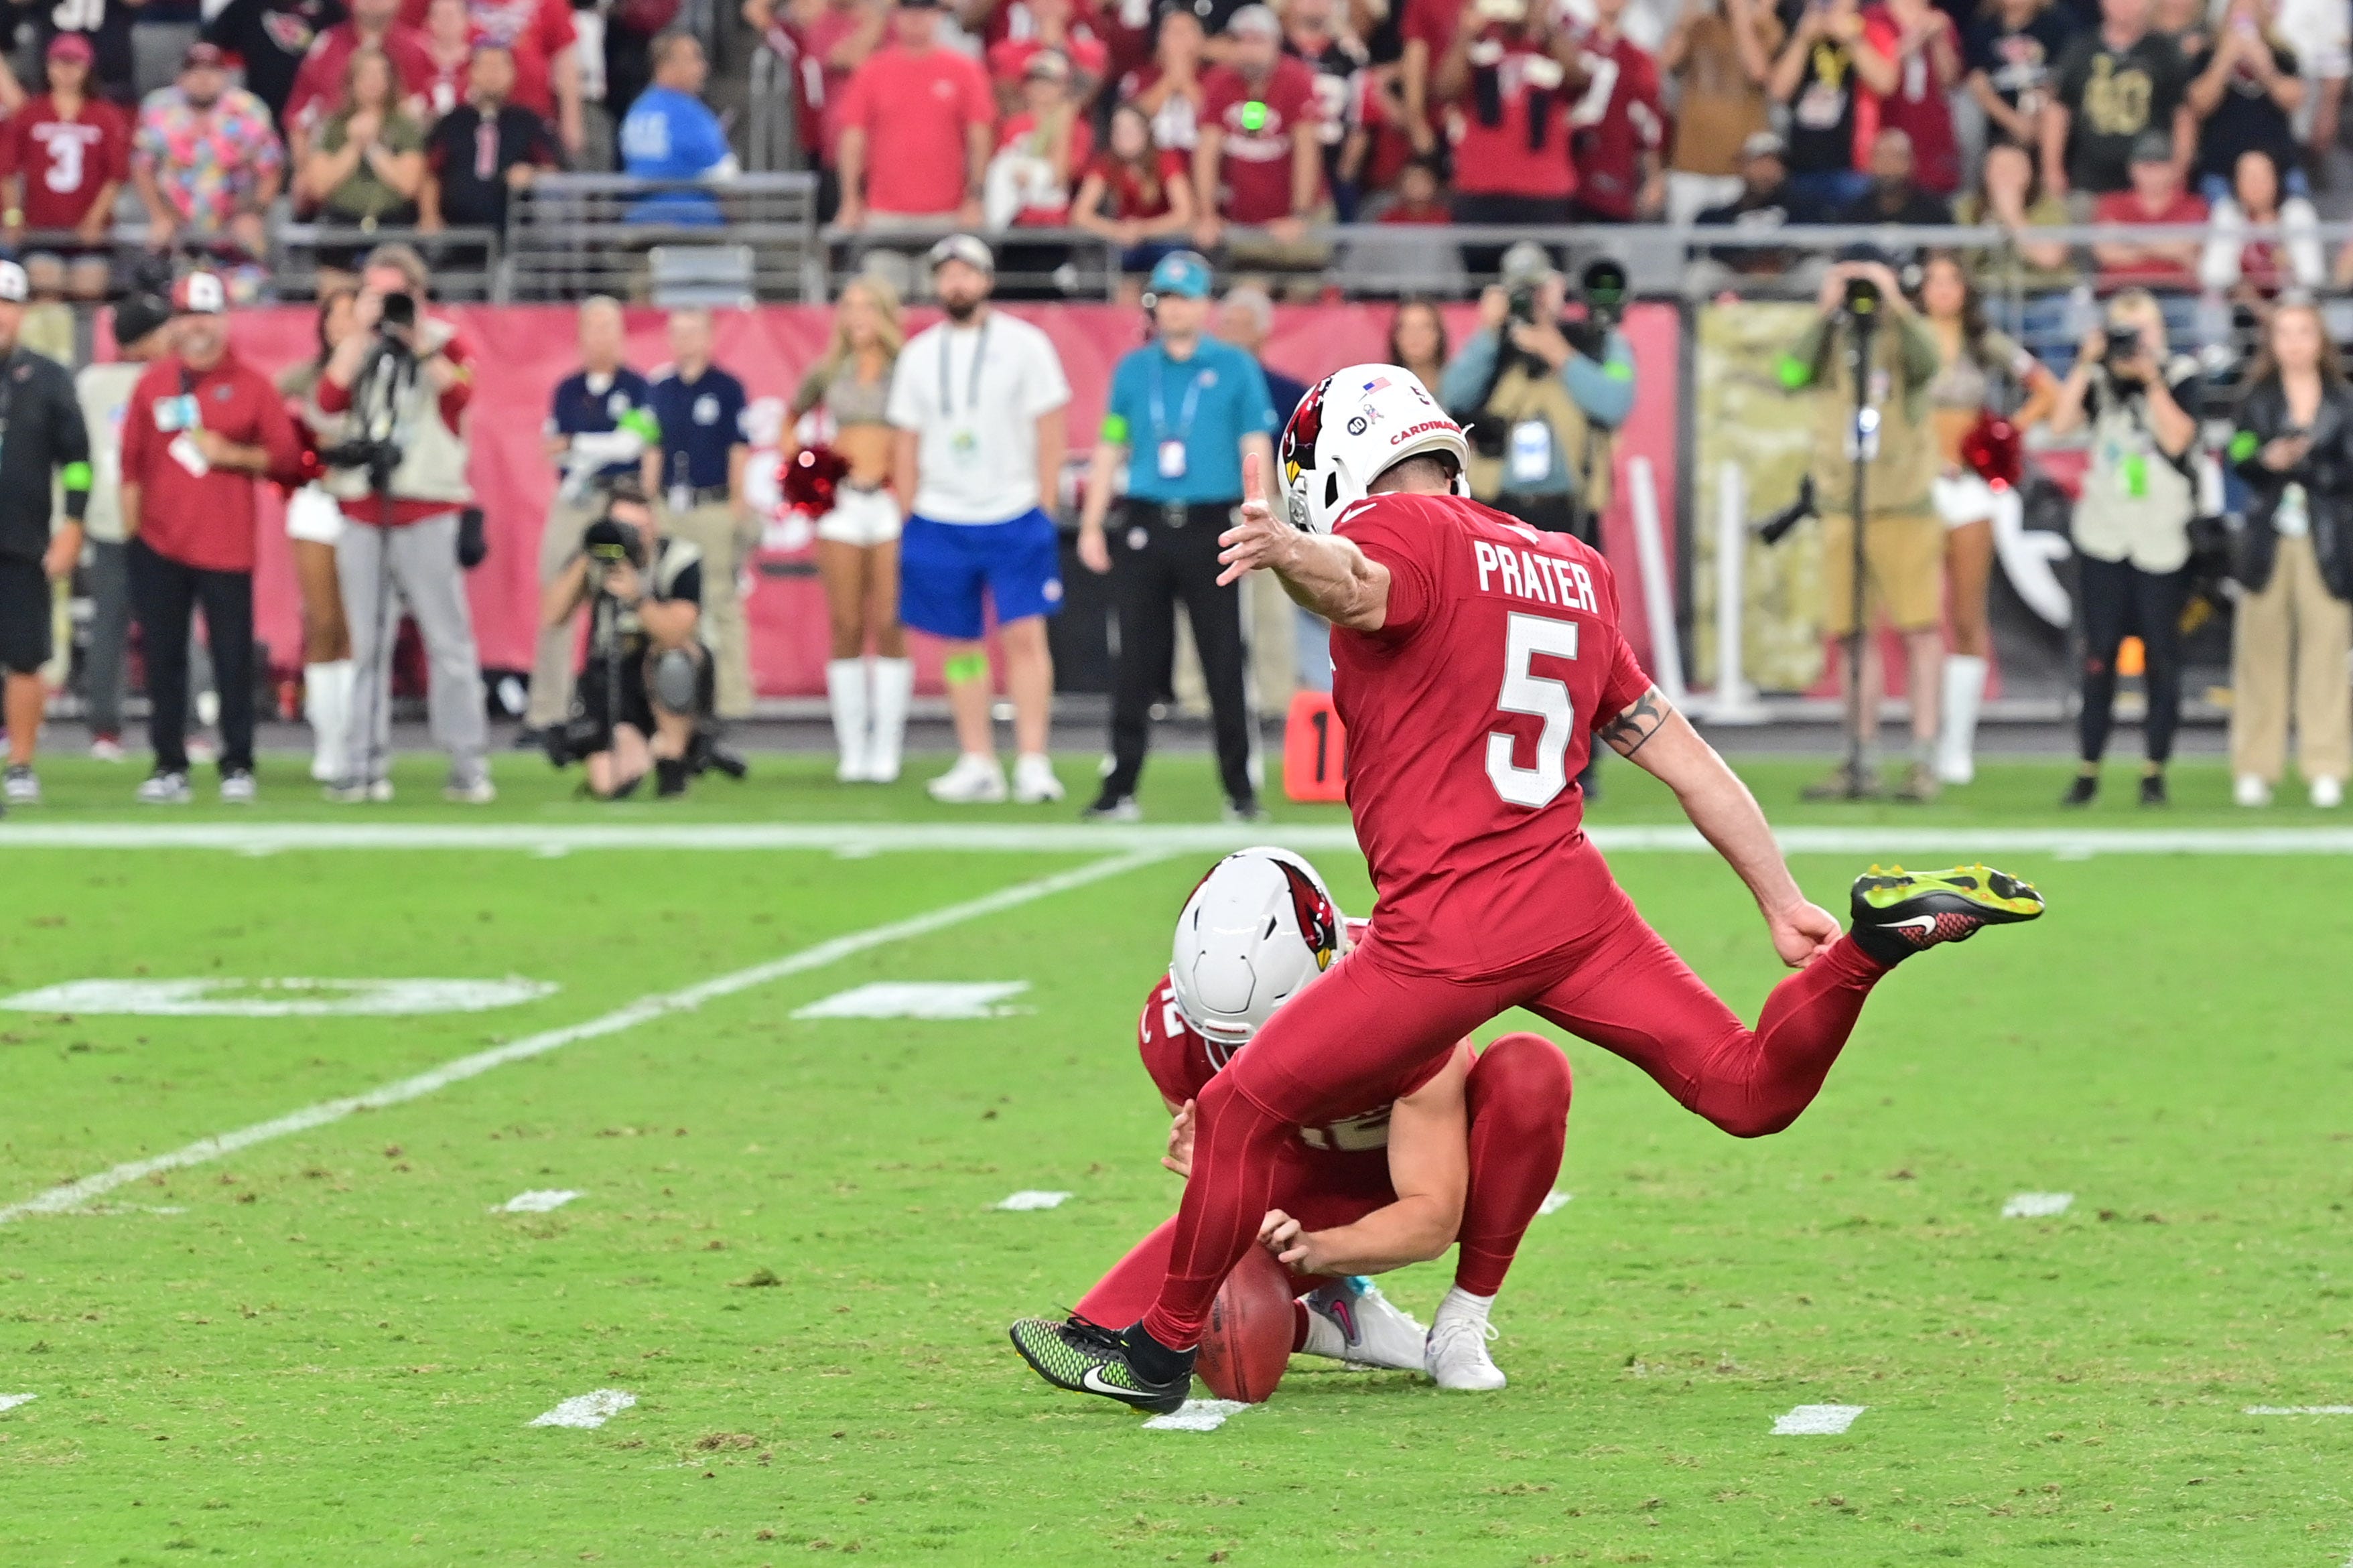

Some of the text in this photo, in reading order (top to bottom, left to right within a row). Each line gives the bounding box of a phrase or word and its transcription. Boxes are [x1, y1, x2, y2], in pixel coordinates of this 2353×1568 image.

[45, 133, 85, 194] 3
[1349, 417, 1365, 433] 40
[1474, 540, 1598, 614] PRATER
[1485, 610, 1578, 808] 5
